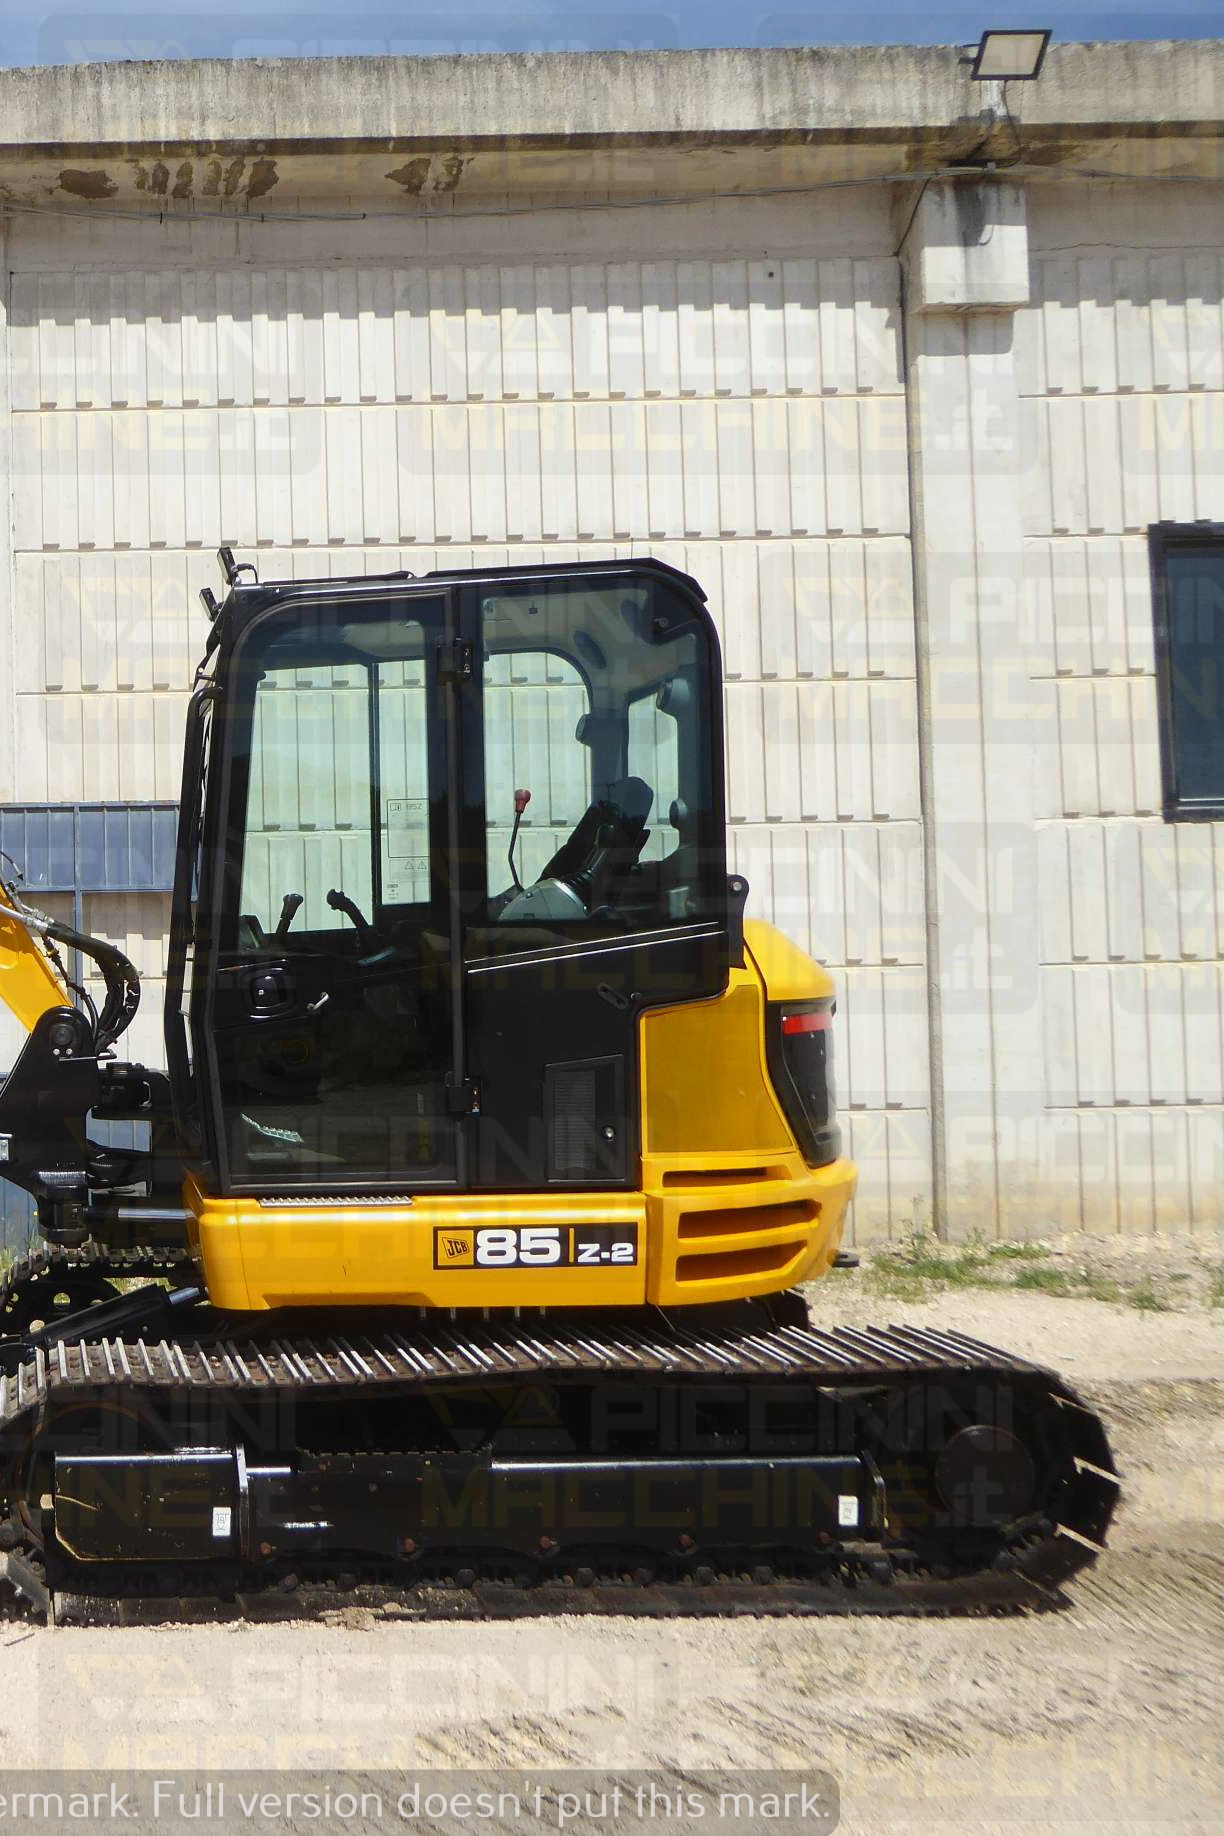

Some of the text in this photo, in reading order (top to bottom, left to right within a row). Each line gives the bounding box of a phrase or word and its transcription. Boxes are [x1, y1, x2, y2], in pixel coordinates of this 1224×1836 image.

[447, 1239, 468, 1256] JCB
[476, 1228, 634, 1265] 85 Z-2
